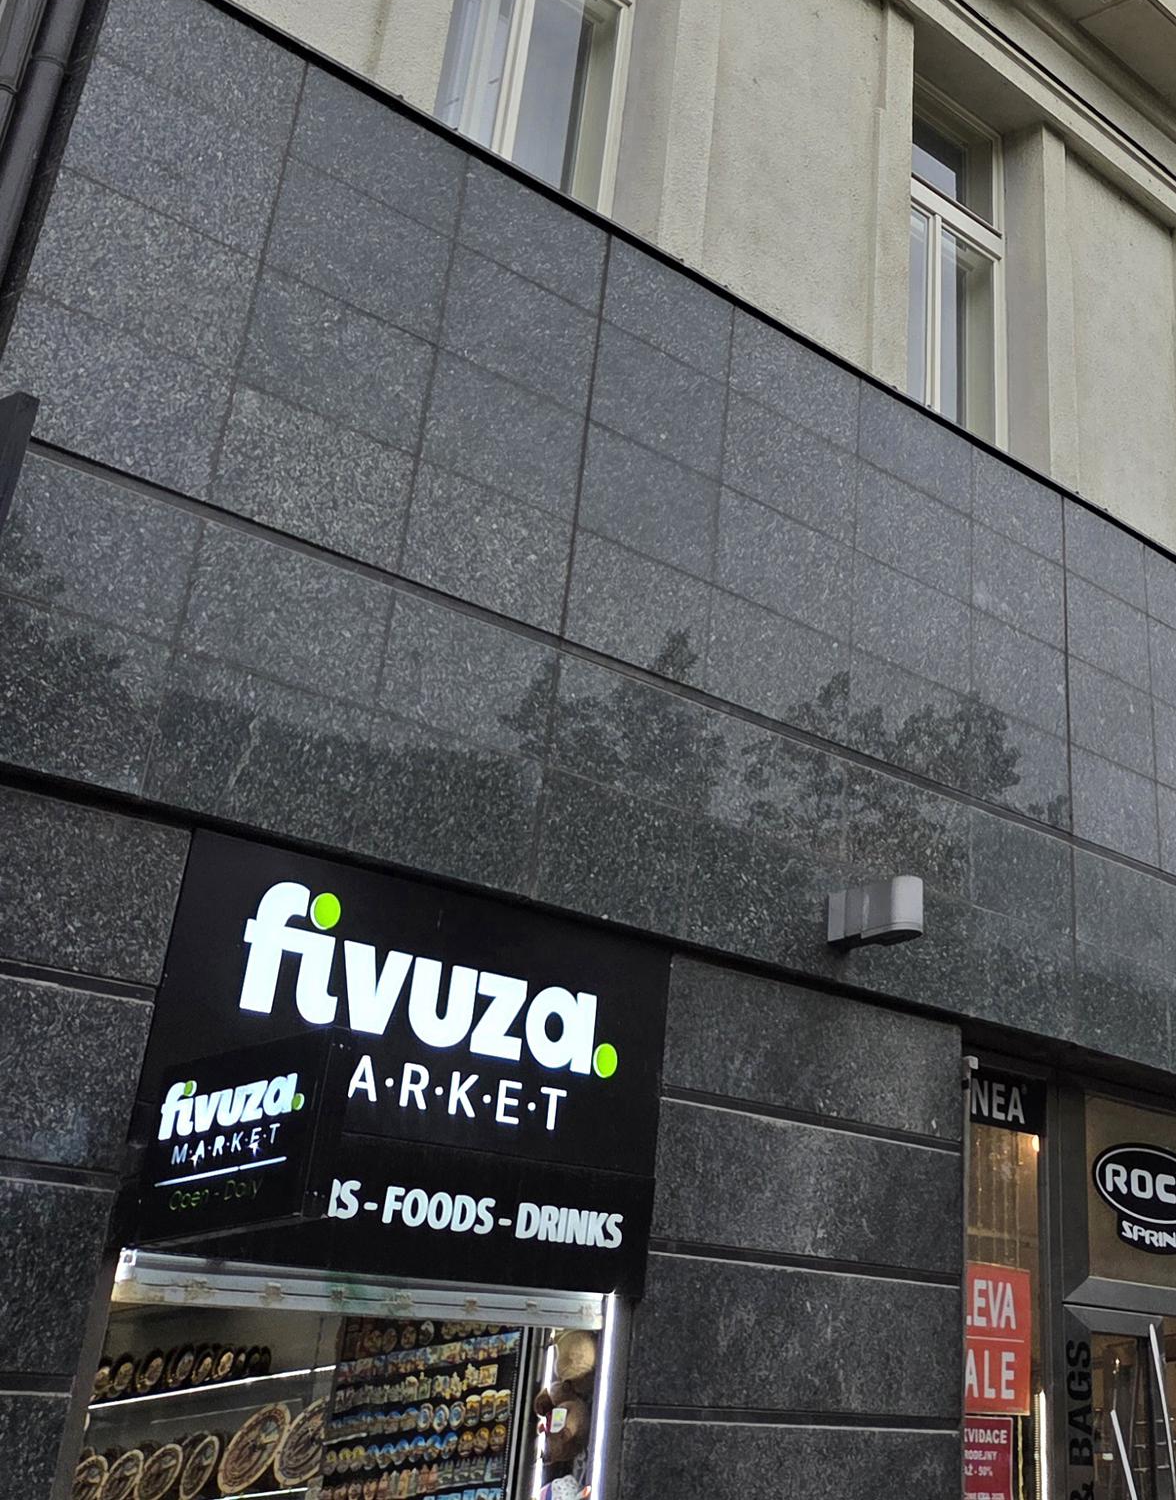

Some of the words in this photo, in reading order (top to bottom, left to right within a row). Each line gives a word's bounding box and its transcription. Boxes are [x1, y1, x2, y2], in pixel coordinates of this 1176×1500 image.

[382, 1186, 496, 1234] FOODS
[515, 1202, 624, 1249] DRINKS
[967, 1279, 1017, 1330] EVA
[1065, 1338, 1094, 1467] BAGS
